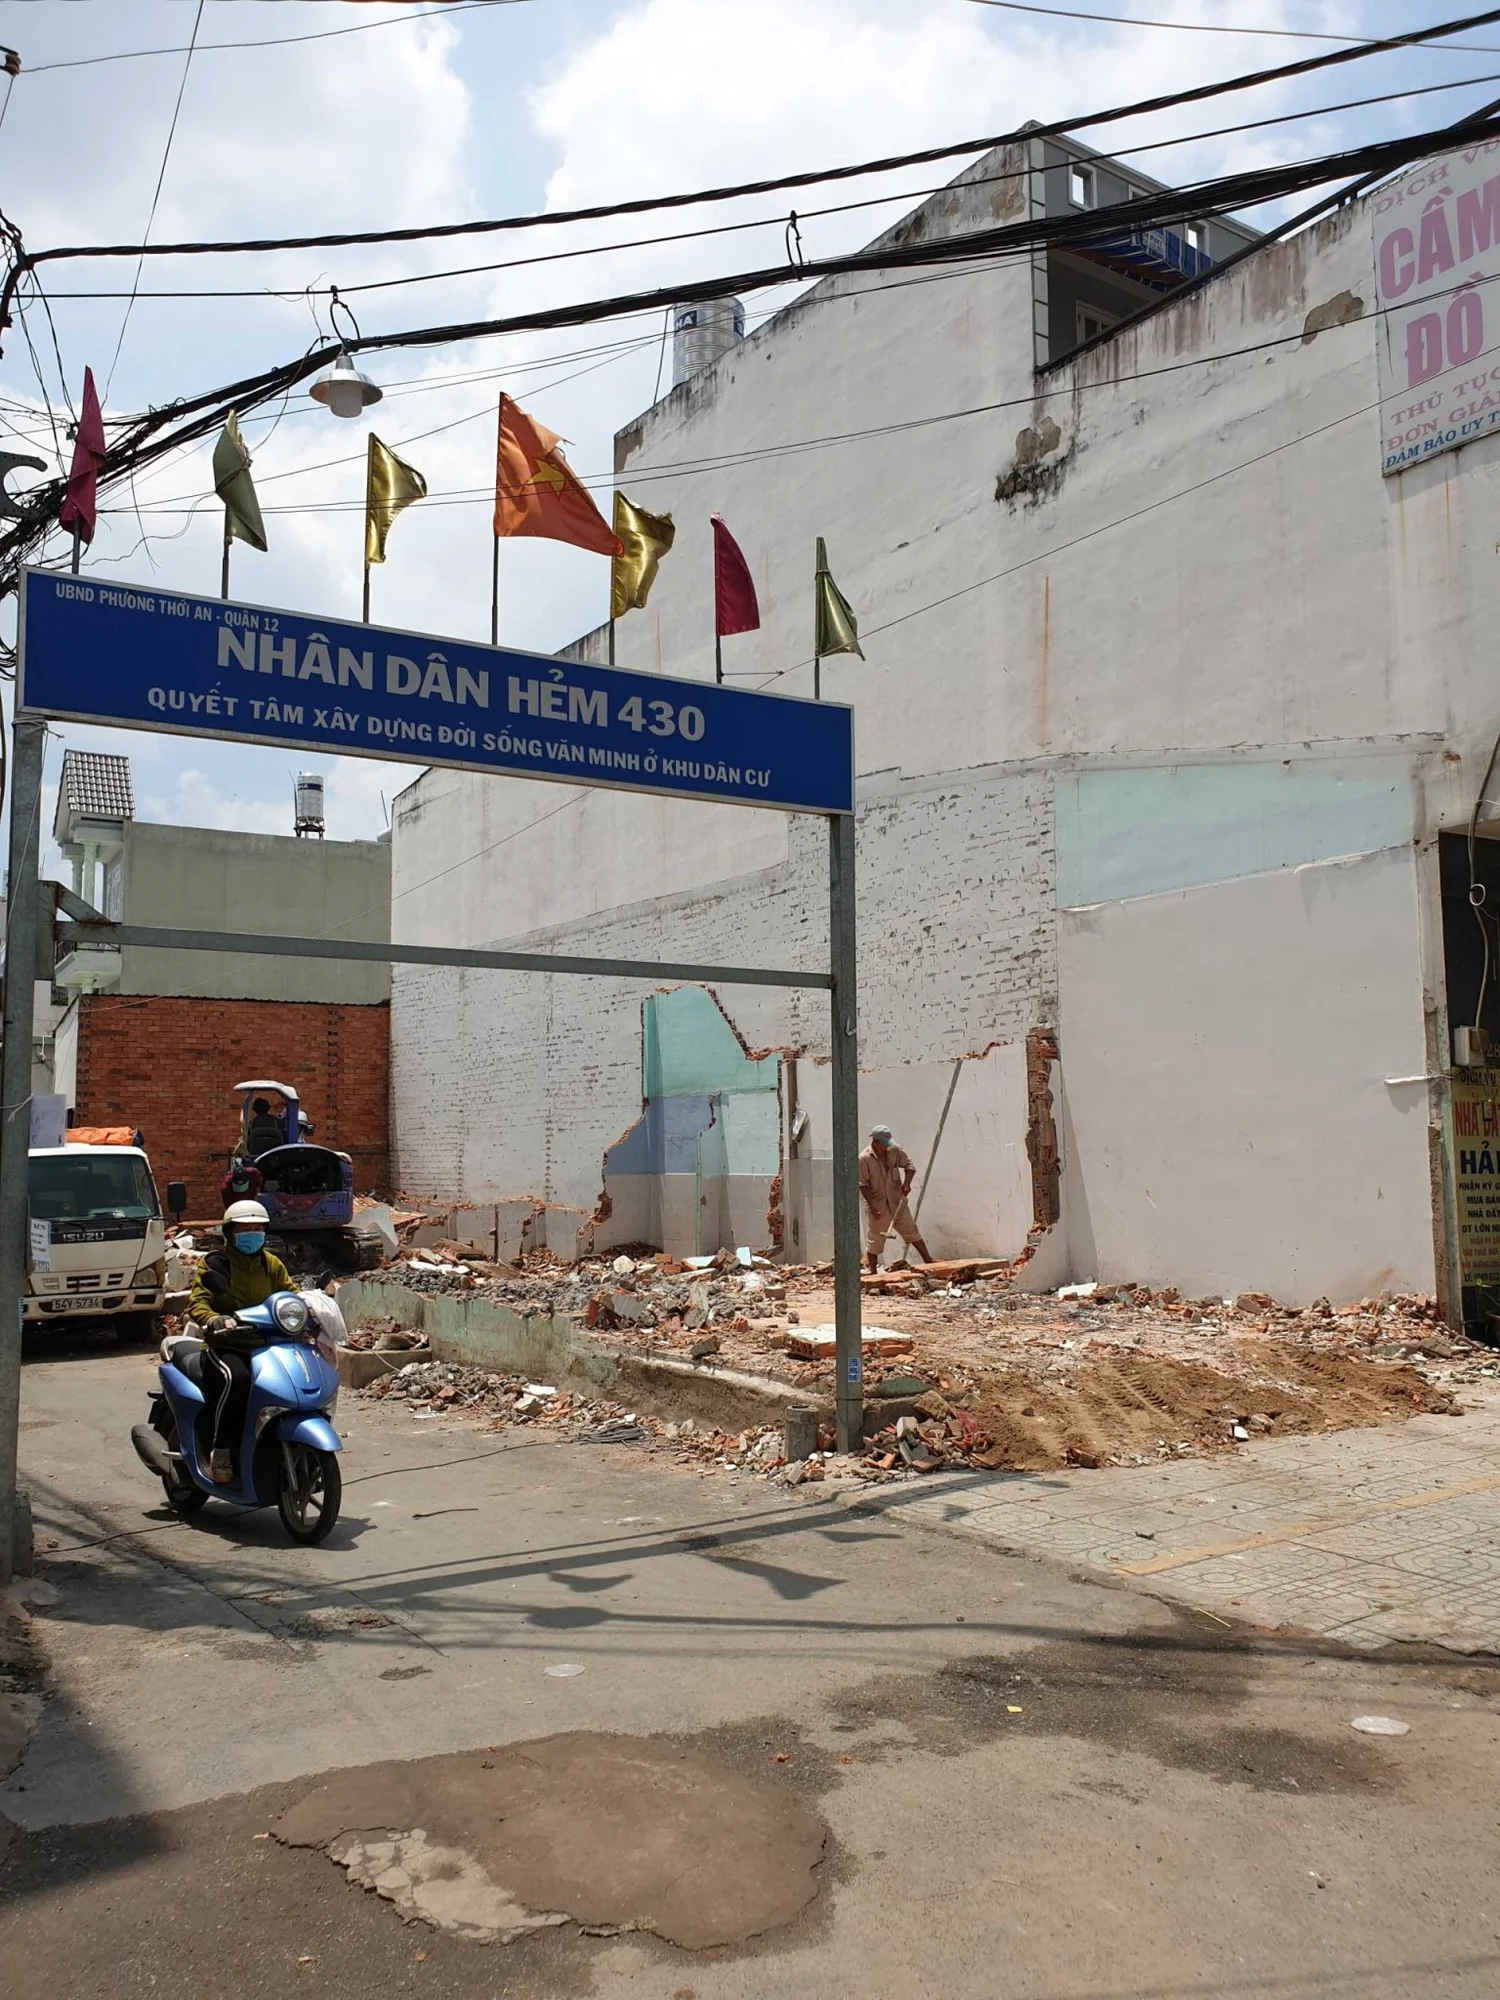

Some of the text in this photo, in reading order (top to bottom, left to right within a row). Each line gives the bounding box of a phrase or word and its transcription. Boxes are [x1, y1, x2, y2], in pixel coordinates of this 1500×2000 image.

[1374, 162, 1450, 217] DỊCH
[1380, 173, 1500, 299] CẦM
[1405, 271, 1484, 388] ĐỒ
[1387, 390, 1500, 452] ĐƠN GIẢ
[1390, 390, 1443, 426] THỦ
[1386, 445, 1420, 469] ĐẢM
[1423, 430, 1457, 452] BẢO
[1461, 416, 1484, 436] UY
[55, 582, 95, 602] UBND
[159, 598, 190, 618] THỚI
[194, 605, 212, 621] AN
[224, 610, 259, 630] QUẬN
[263, 617, 279, 632] 12
[217, 626, 705, 741] NHÂN DÂN HẺM 430
[147, 681, 771, 788] QUYẾT TÂM XÂY DỰNG ĐỜI SỐNG VĂN MINH Ở KHU DÂN CƯ
[1467, 1195, 1483, 1204] MUA
[63, 1232, 104, 1242] ISUZU
